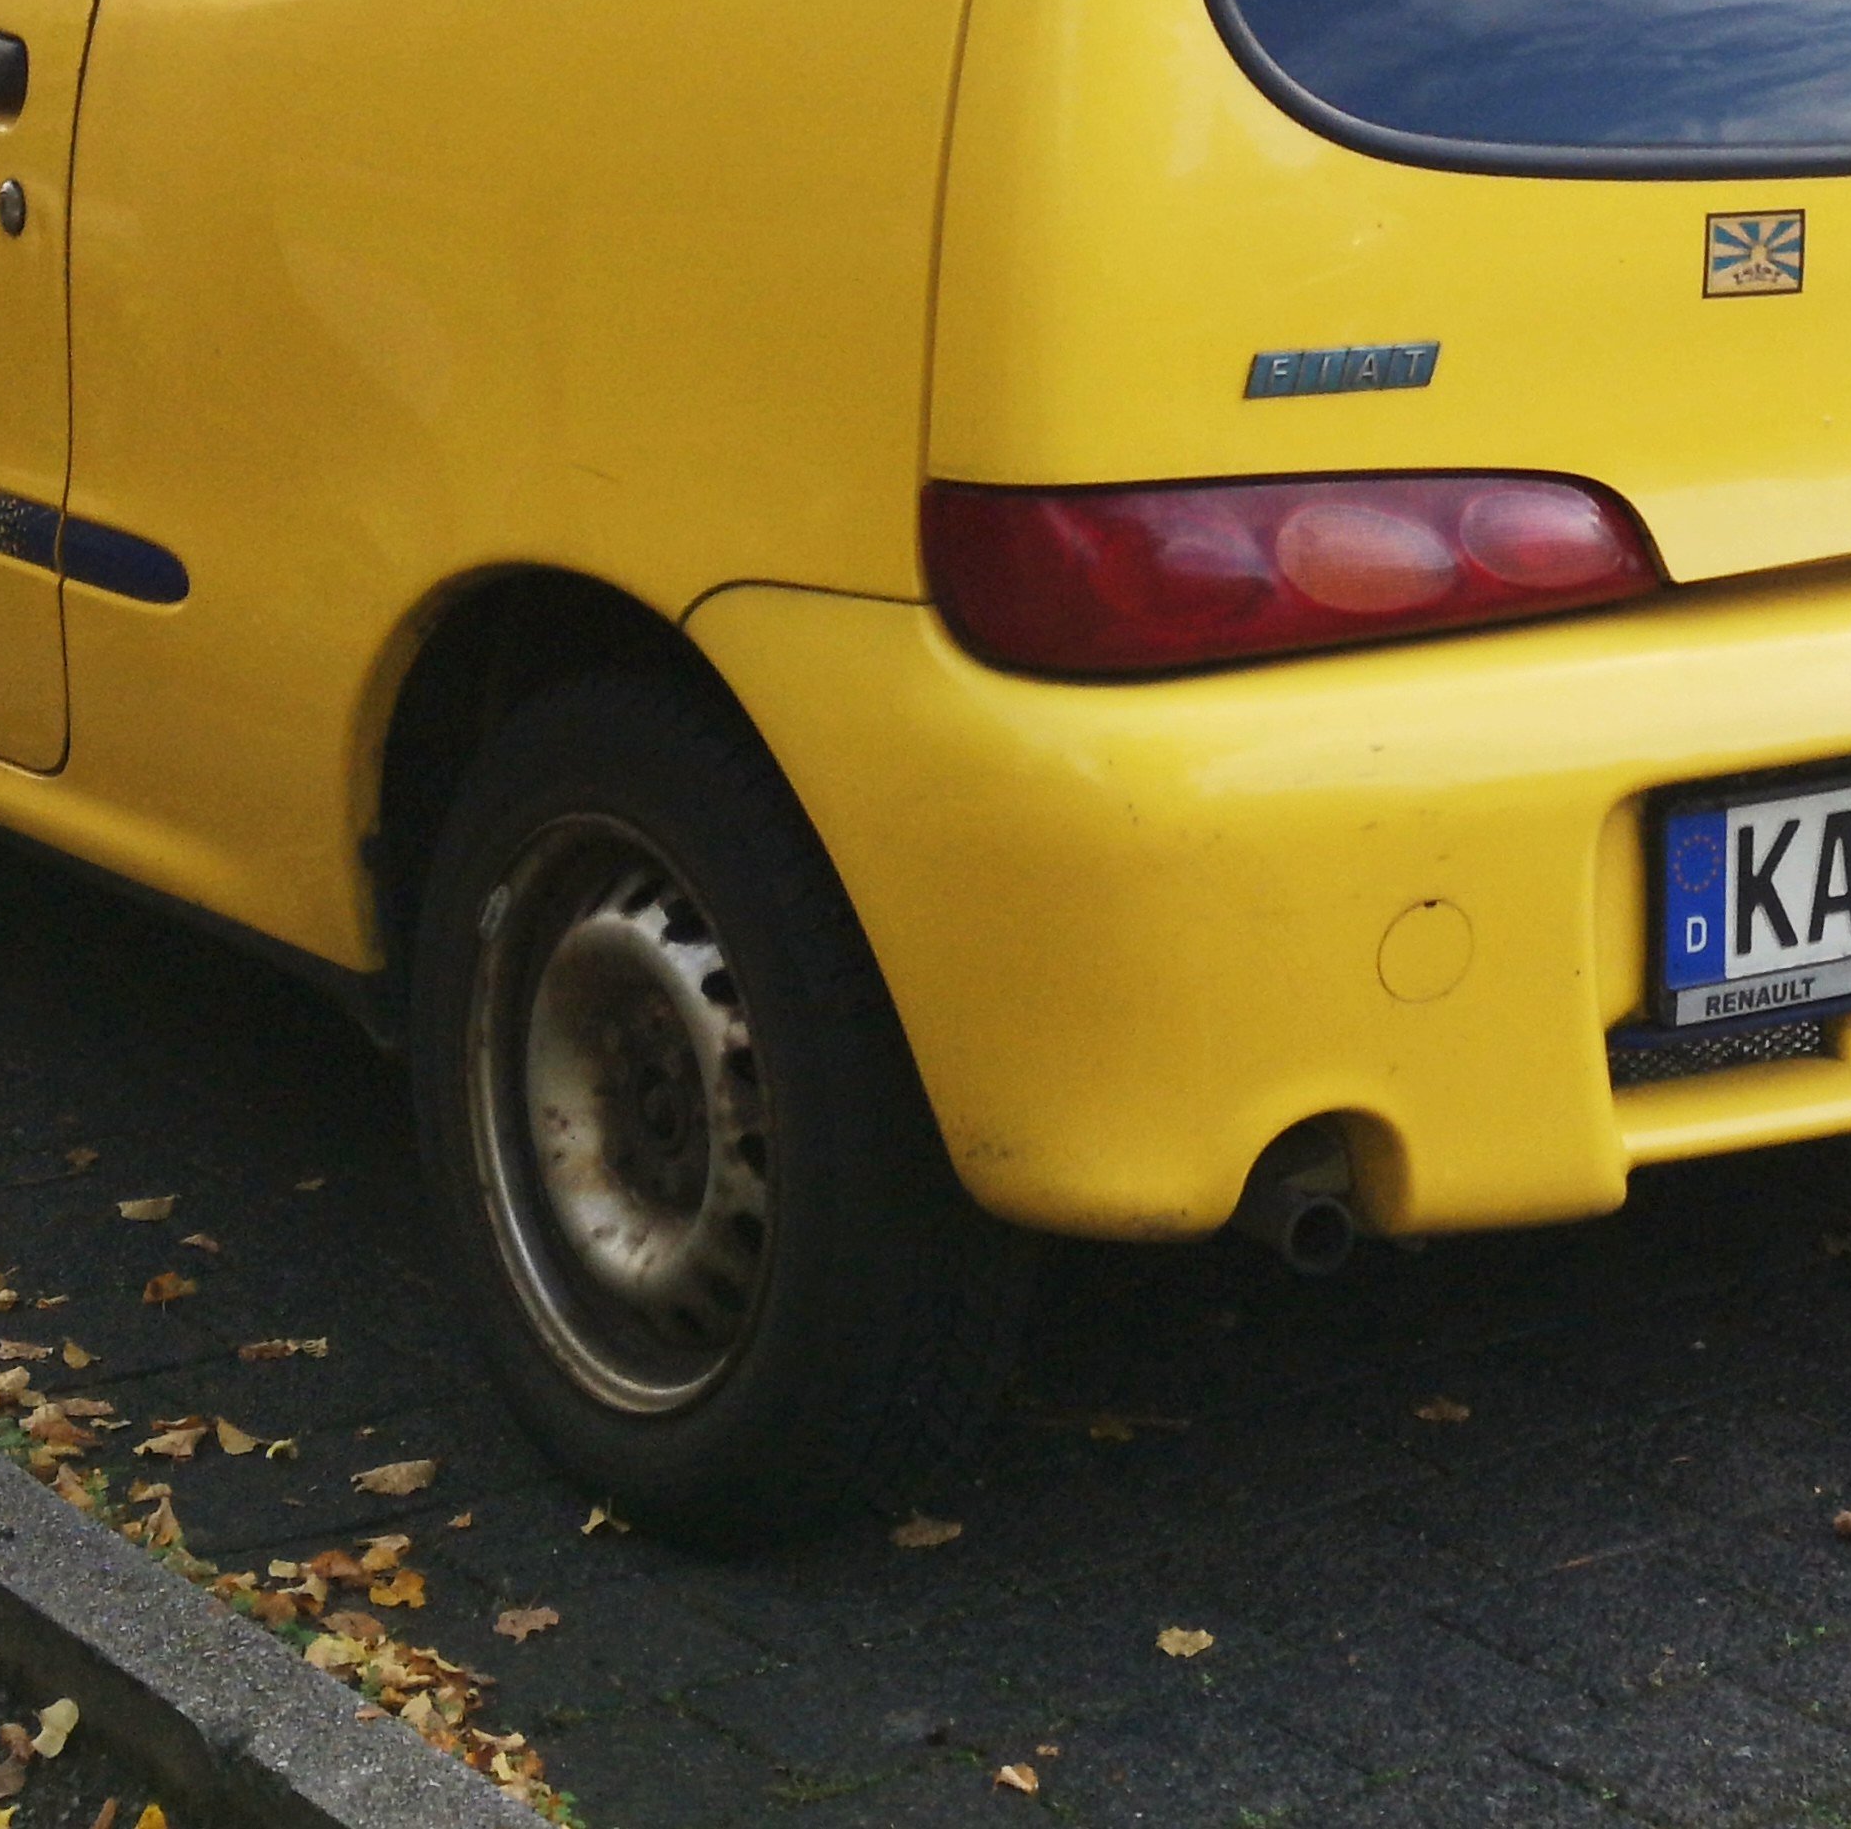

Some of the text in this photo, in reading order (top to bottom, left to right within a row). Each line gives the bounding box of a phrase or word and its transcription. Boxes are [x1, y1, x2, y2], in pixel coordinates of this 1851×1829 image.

[1266, 346, 1428, 385] FIAT
[1685, 916, 1708, 954] D
[1705, 978, 1815, 1017] RENAULT
